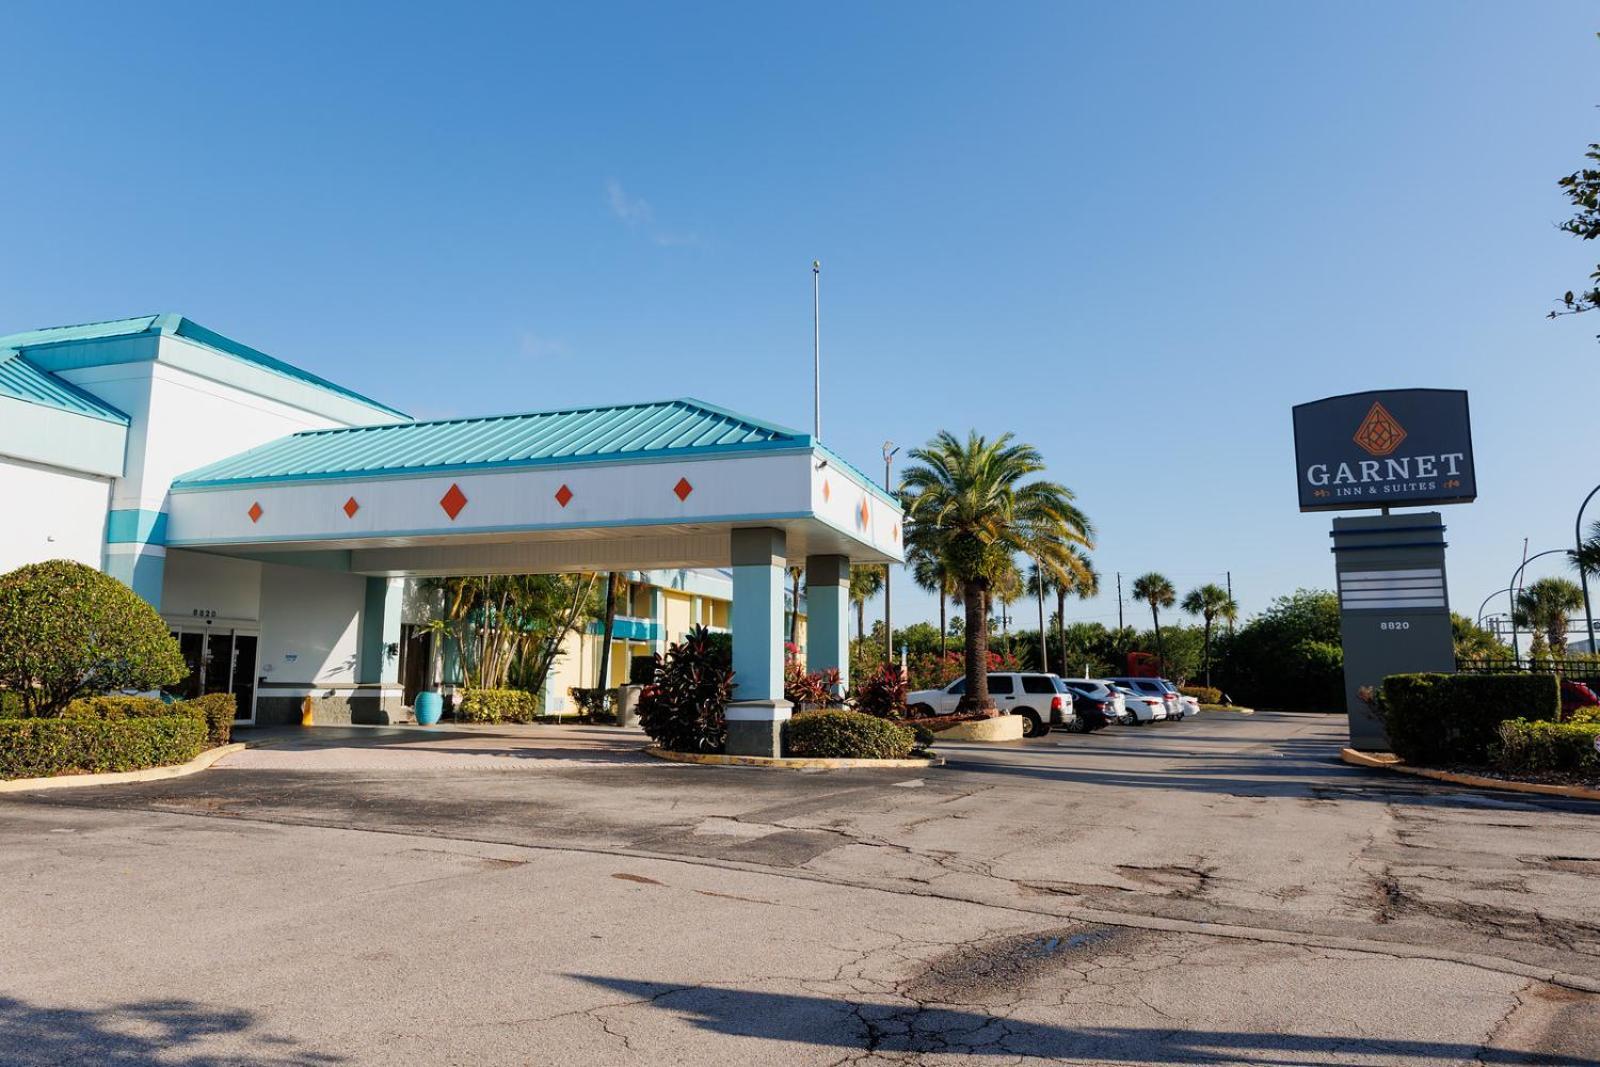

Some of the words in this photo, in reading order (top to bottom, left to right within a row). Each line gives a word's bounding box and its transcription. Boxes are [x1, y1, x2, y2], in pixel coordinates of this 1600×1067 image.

[1307, 453, 1463, 486] GARNET
[1336, 487, 1362, 496] INN
[1369, 485, 1377, 494] &
[1383, 482, 1436, 493] SUITES
[1380, 622, 1409, 630] 8820
